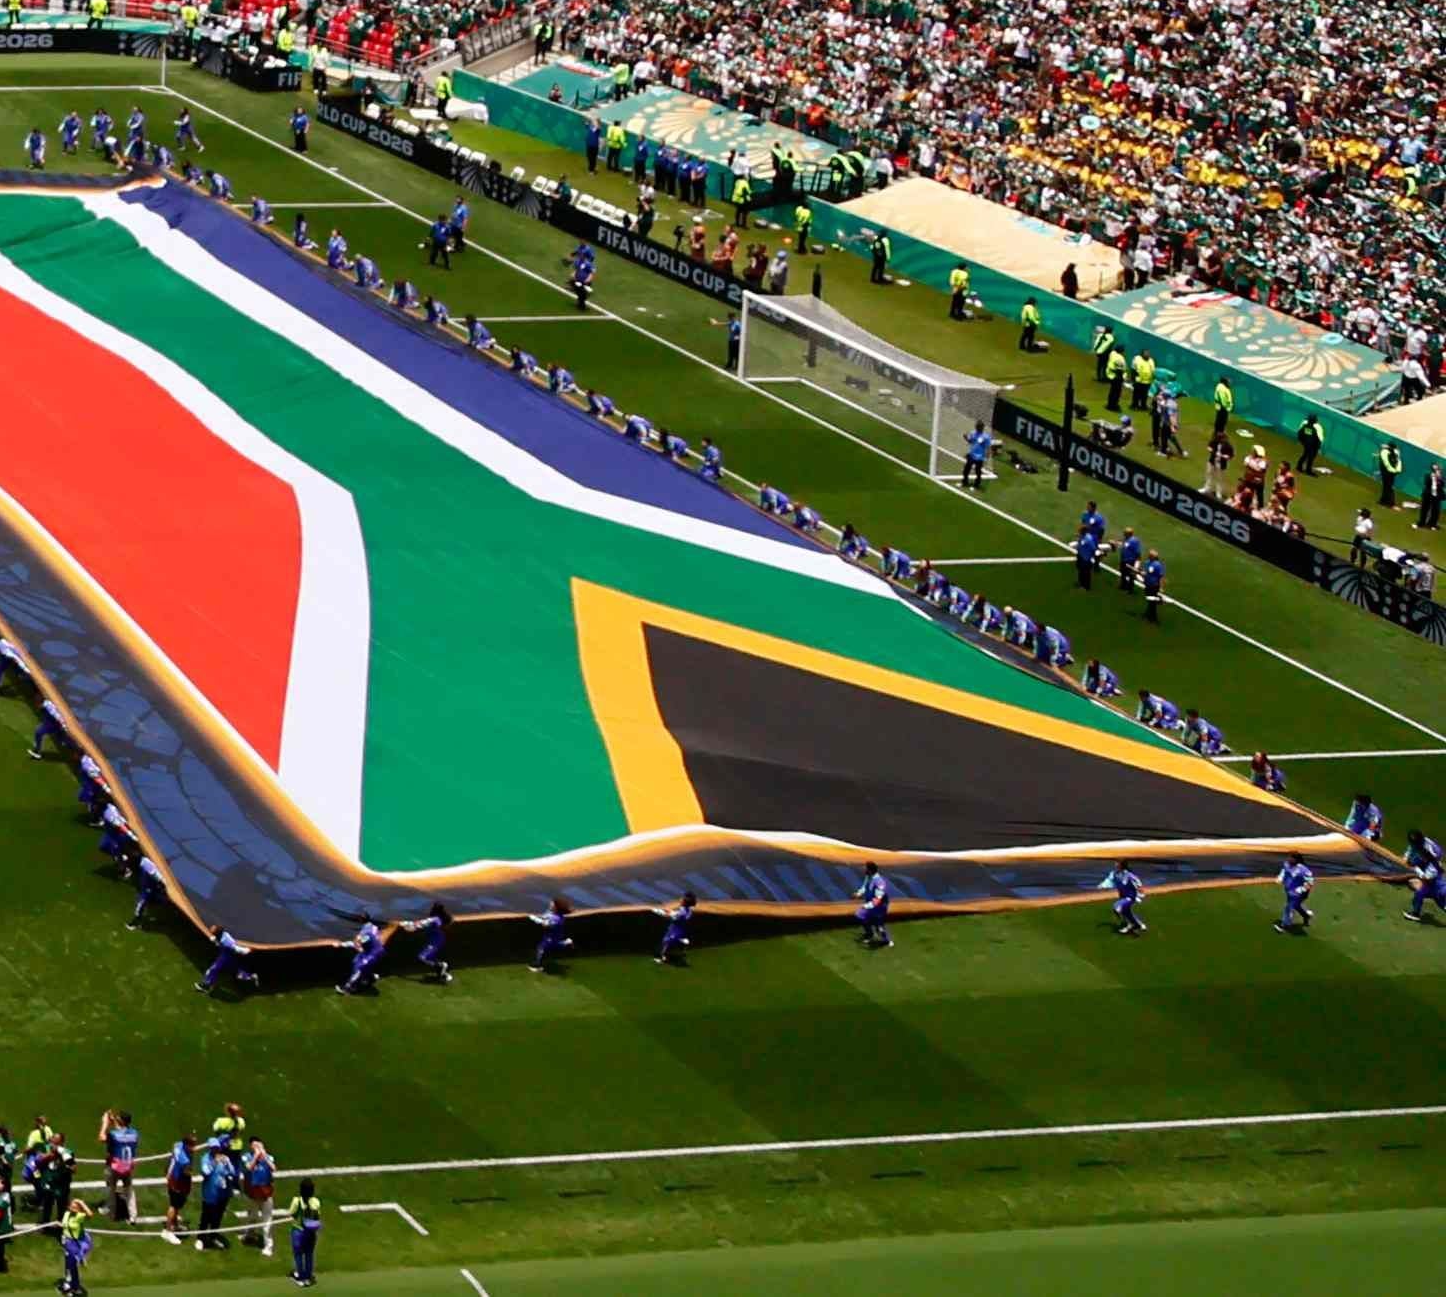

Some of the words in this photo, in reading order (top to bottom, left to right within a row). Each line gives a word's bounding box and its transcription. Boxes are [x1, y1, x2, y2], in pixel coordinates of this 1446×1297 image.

[342, 111, 367, 134] CUP
[367, 128, 414, 157] 2026
[598, 225, 631, 257] FIFA
[634, 236, 689, 281] WORLD
[694, 264, 726, 293] CUP
[1015, 415, 1056, 448] FIFA
[1132, 469, 1173, 504] CUP
[1176, 491, 1251, 544] 2026
